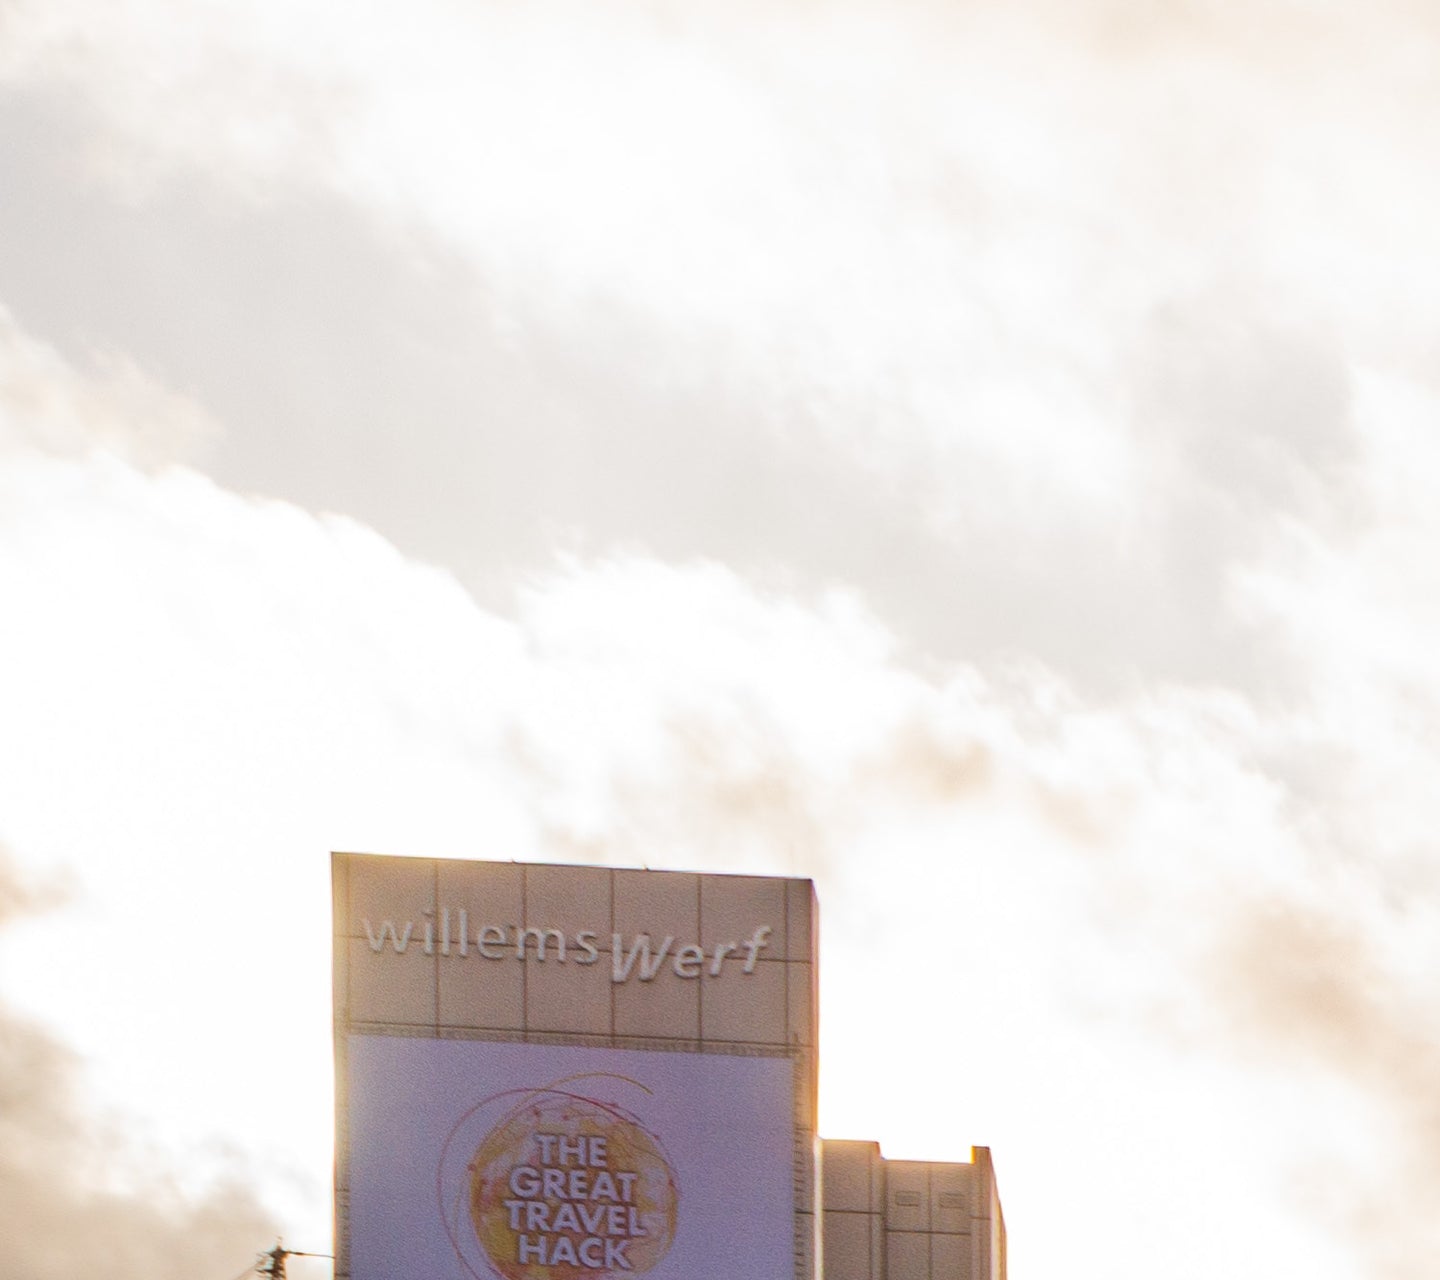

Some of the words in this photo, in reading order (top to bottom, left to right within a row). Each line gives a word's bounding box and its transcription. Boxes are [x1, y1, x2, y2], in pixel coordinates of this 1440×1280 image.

[362, 907, 772, 983] willemsWerf
[535, 1134, 608, 1167] THE
[509, 1166, 638, 1202] GREAT
[504, 1200, 648, 1236] TRAVEL
[518, 1234, 632, 1269] HACK
